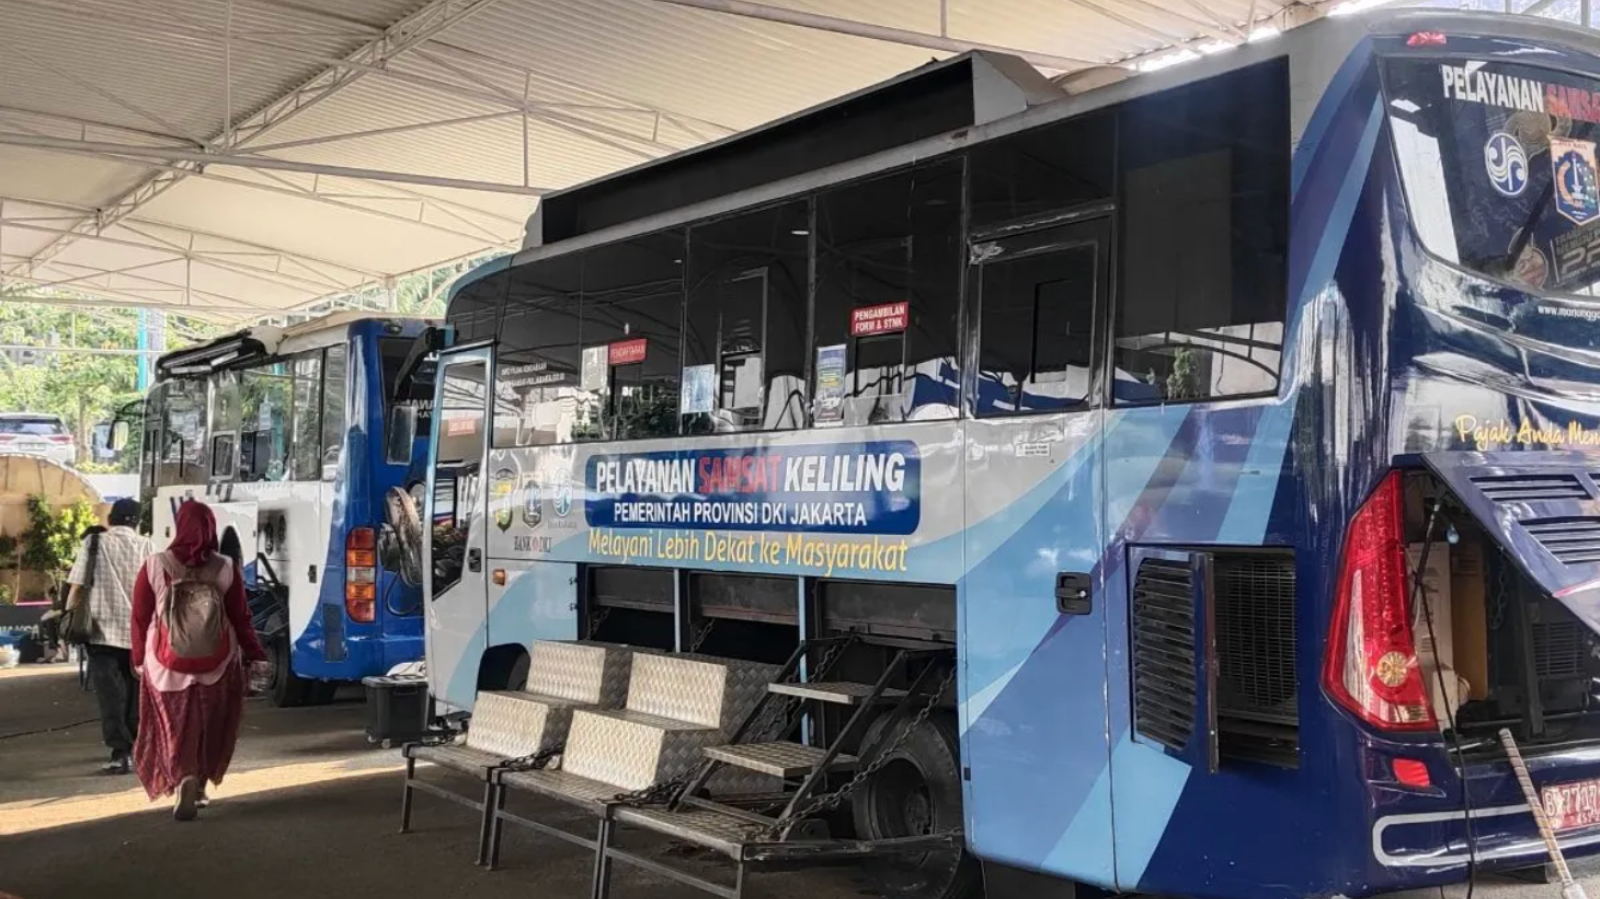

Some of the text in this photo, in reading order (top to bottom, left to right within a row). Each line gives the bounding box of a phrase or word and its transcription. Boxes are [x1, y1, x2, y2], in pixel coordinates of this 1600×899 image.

[1441, 63, 1544, 113] PELAYANAN
[854, 304, 905, 321] PENGAMBILAN
[855, 320, 875, 333] FORM
[883, 317, 904, 329] STNK
[1455, 414, 1512, 452] Pajak
[1516, 415, 1565, 445] Anda
[596, 452, 906, 493] PELAYANAN SAMSAT KELILING
[614, 502, 868, 526] PEMERINTAH PROVINSI DKI JAKARTA
[589, 527, 908, 577] Melayani Lebih Dekat ke Masyarakat
[1545, 790, 1556, 817] B
